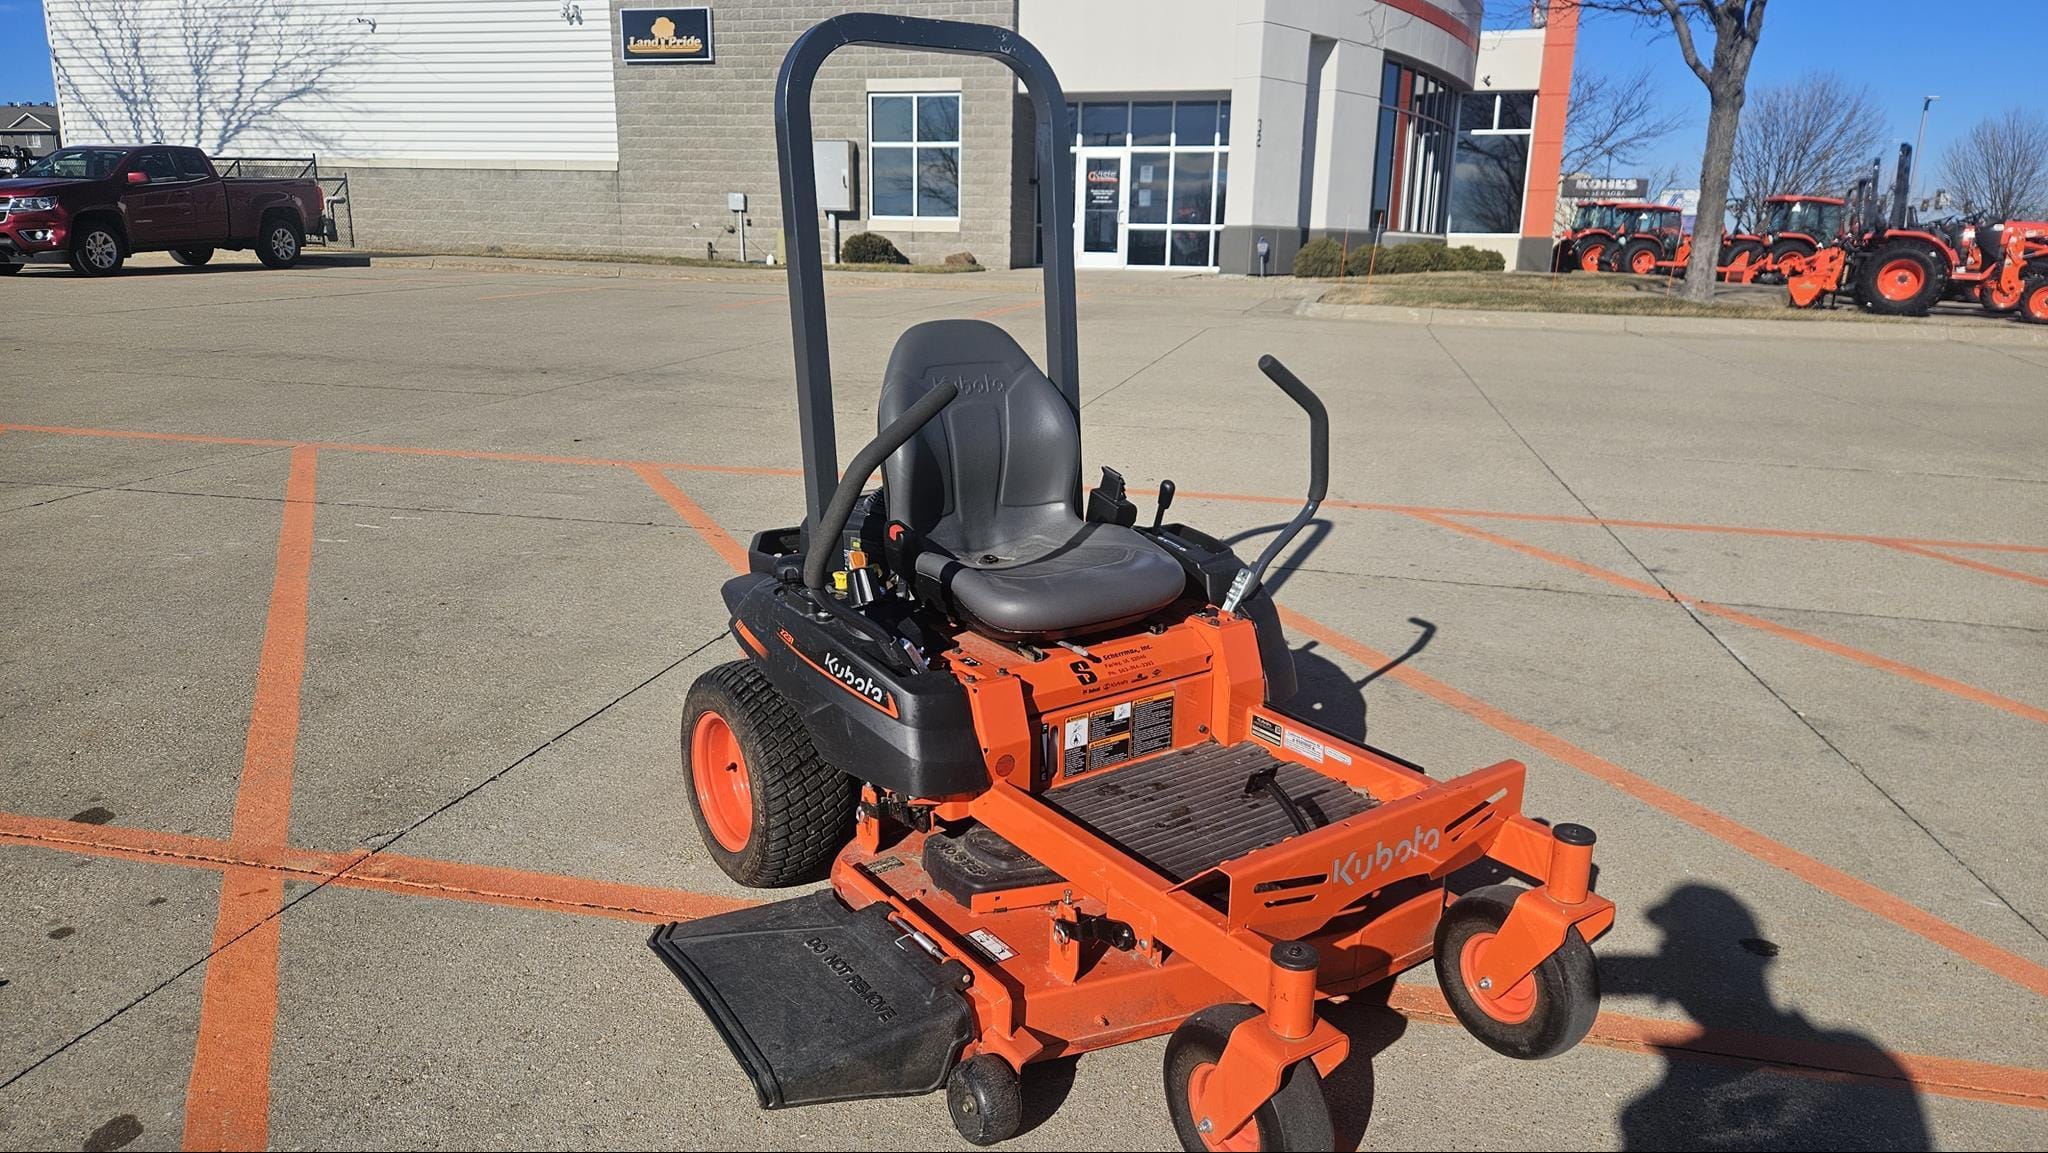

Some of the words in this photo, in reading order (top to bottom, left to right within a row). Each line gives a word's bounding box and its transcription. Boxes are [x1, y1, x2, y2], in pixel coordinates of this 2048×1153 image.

[628, 36, 660, 47] Land
[668, 35, 701, 47] Pride
[1575, 179, 1638, 191] KOHL'S
[824, 652, 883, 702] Kubota
[1333, 825, 1440, 886] Kubota
[803, 937, 829, 955] DO
[823, 954, 854, 976] NOT
[844, 974, 898, 1023] REMOVE
